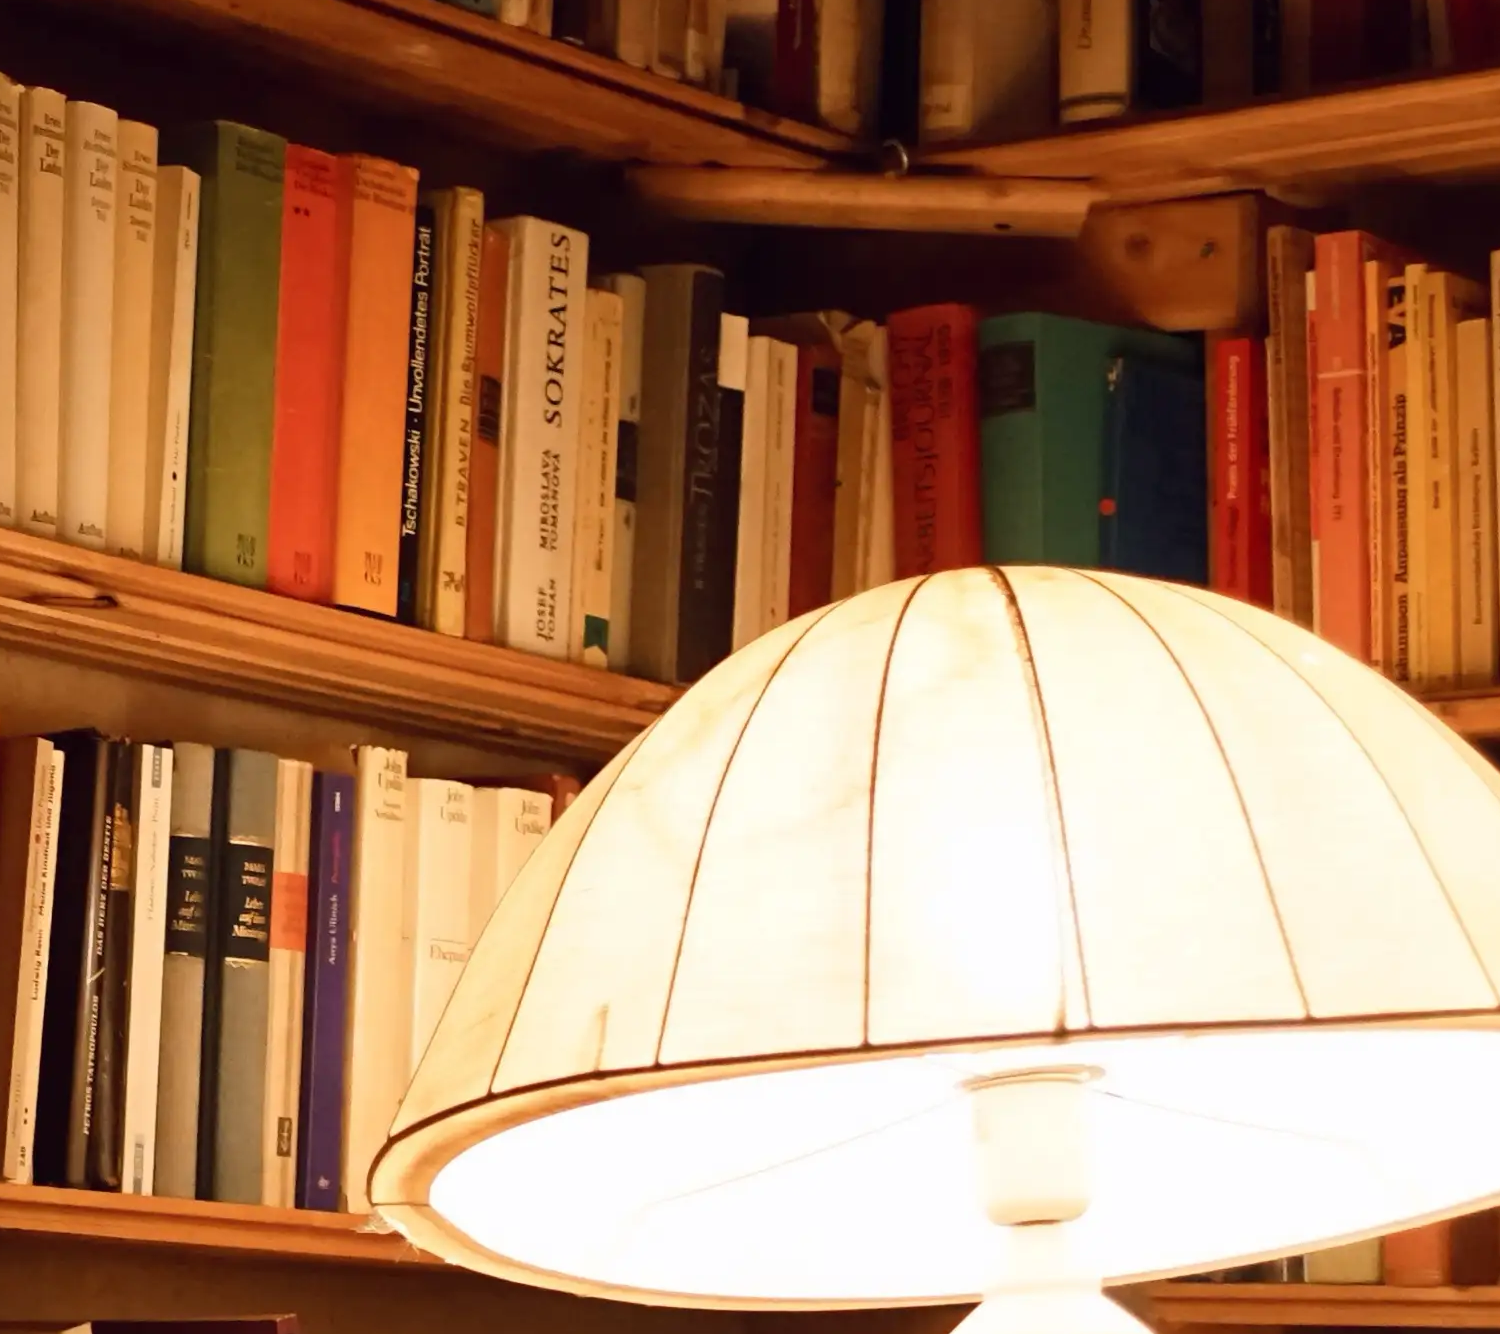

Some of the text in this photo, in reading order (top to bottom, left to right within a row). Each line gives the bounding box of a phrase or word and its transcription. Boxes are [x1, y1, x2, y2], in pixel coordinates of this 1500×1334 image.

[401, 226, 432, 538] Tschakowski Unvollendetes Porträt
[455, 218, 482, 508] TRAVEN Die Baumwollpflücker
[542, 233, 571, 429] SOKRATES
[1223, 355, 1241, 440] Frühförderung
[538, 449, 551, 550] MIROSLAVA
[1225, 441, 1240, 462] der
[1225, 465, 1240, 500] Praxis
[1392, 393, 1409, 584] Anpassung als Prinzip
[534, 586, 548, 641] JOSEF
[546, 579, 557, 643] TOMAN
[30, 960, 44, 1001] Ludwig
[41, 831, 52, 878] Kindheit
[82, 815, 113, 1135] PETROS TATSOPOULOS DAS HERZ DER BESTIE
